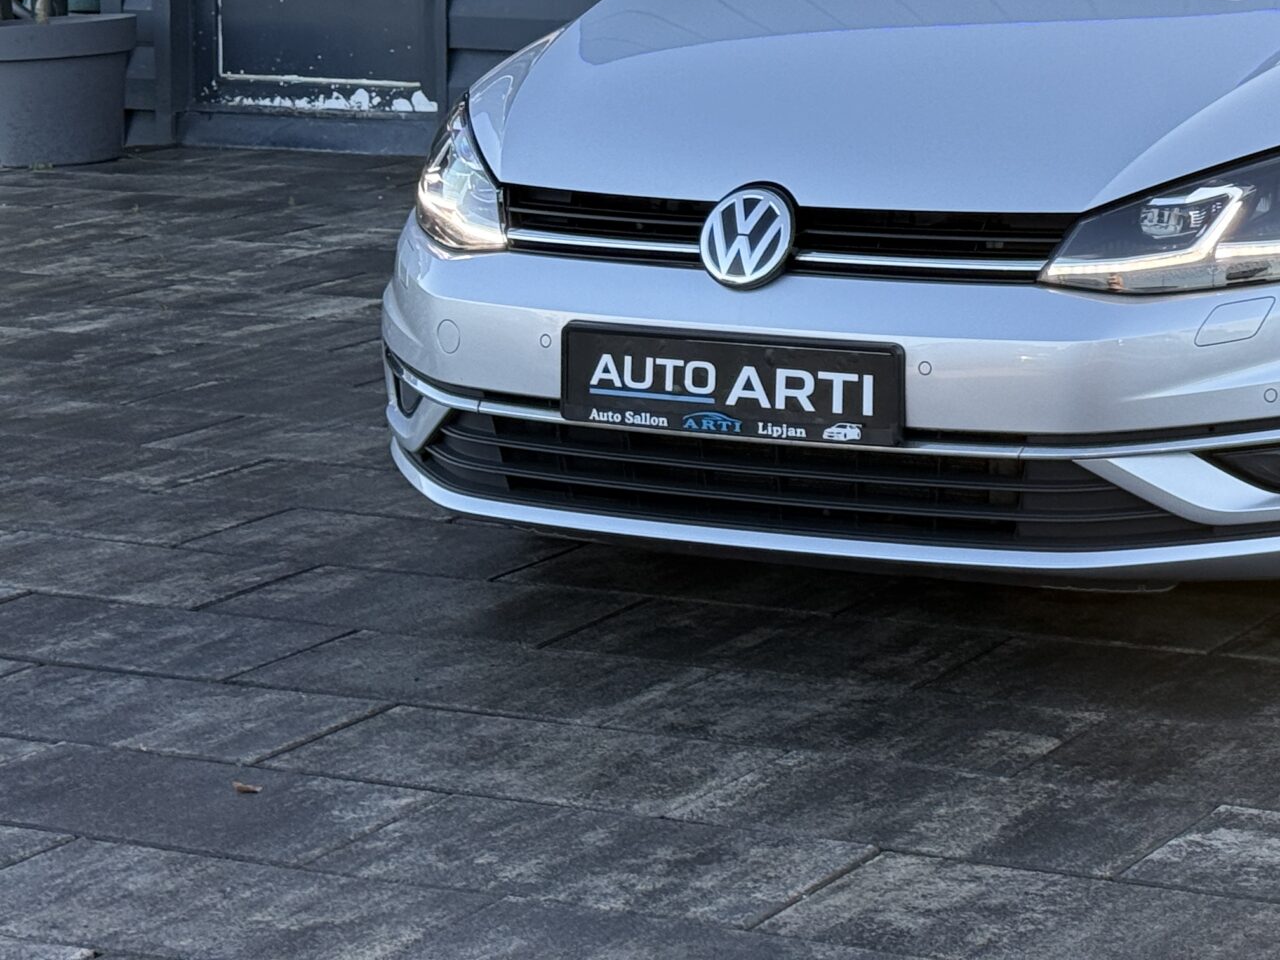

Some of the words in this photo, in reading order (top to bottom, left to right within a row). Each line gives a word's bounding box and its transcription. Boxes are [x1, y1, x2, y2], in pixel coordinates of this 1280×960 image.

[589, 353, 716, 395] AUTO
[725, 365, 874, 417] ARTI
[589, 407, 622, 424] Auto
[624, 411, 669, 427] Sallon
[682, 419, 742, 433] ARTI
[757, 422, 807, 438] Lipjan
